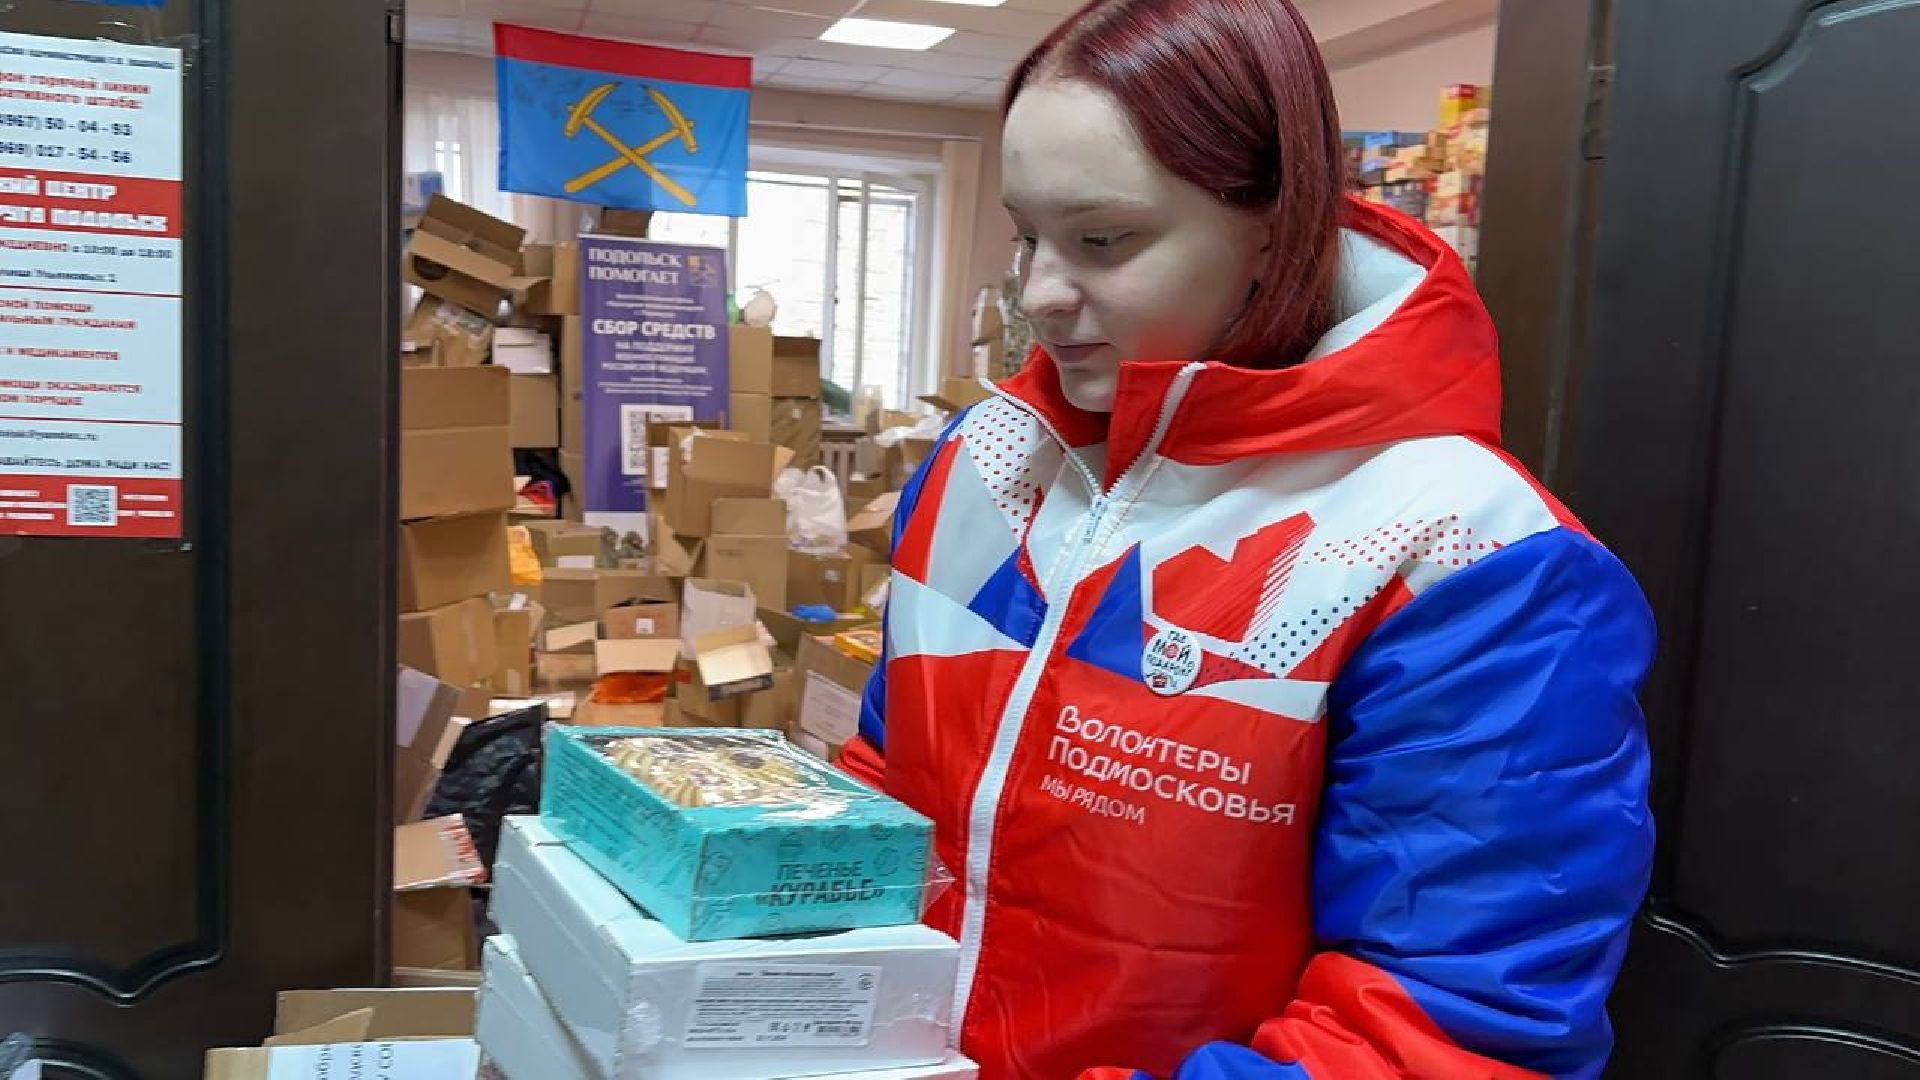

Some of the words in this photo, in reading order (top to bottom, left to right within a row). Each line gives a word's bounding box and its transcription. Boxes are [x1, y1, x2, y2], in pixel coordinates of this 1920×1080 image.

[588, 248, 683, 268] ПОДОЛЬСК
[588, 266, 680, 285] ПОМОГАЕТ
[593, 319, 638, 335] СБОР
[641, 321, 716, 340] СРЕДСТВ
[1048, 735, 1297, 826] ПОДМОСКОВЬЯ
[1039, 774, 1072, 799] МЫ
[1071, 787, 1147, 826] РЯДОМ
[776, 860, 865, 881] ПЕЧЕНЬЕ
